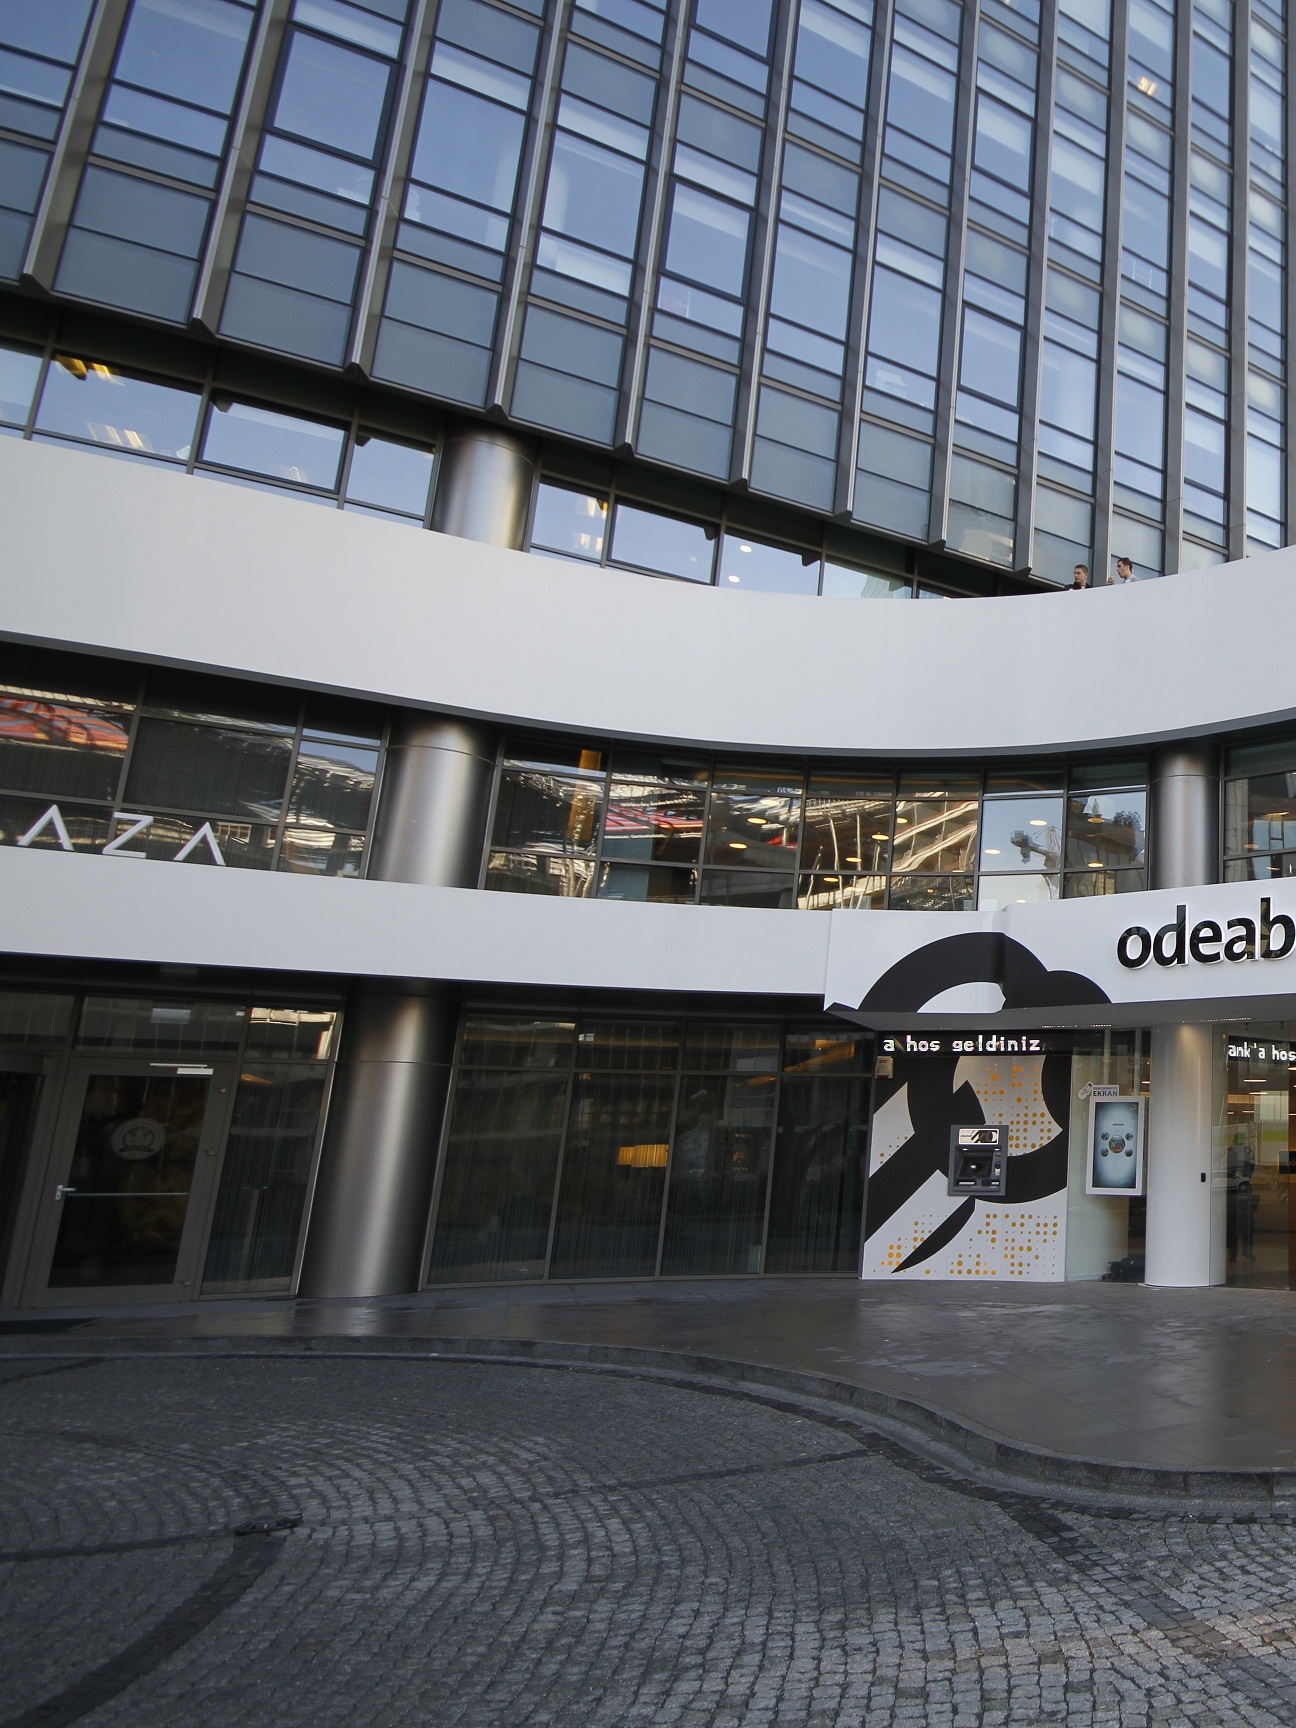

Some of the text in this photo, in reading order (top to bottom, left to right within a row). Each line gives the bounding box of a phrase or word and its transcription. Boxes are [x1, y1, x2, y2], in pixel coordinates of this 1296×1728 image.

[883, 1034, 1041, 1052] a hos geldiniz
[1271, 1045, 1296, 1062] hos
